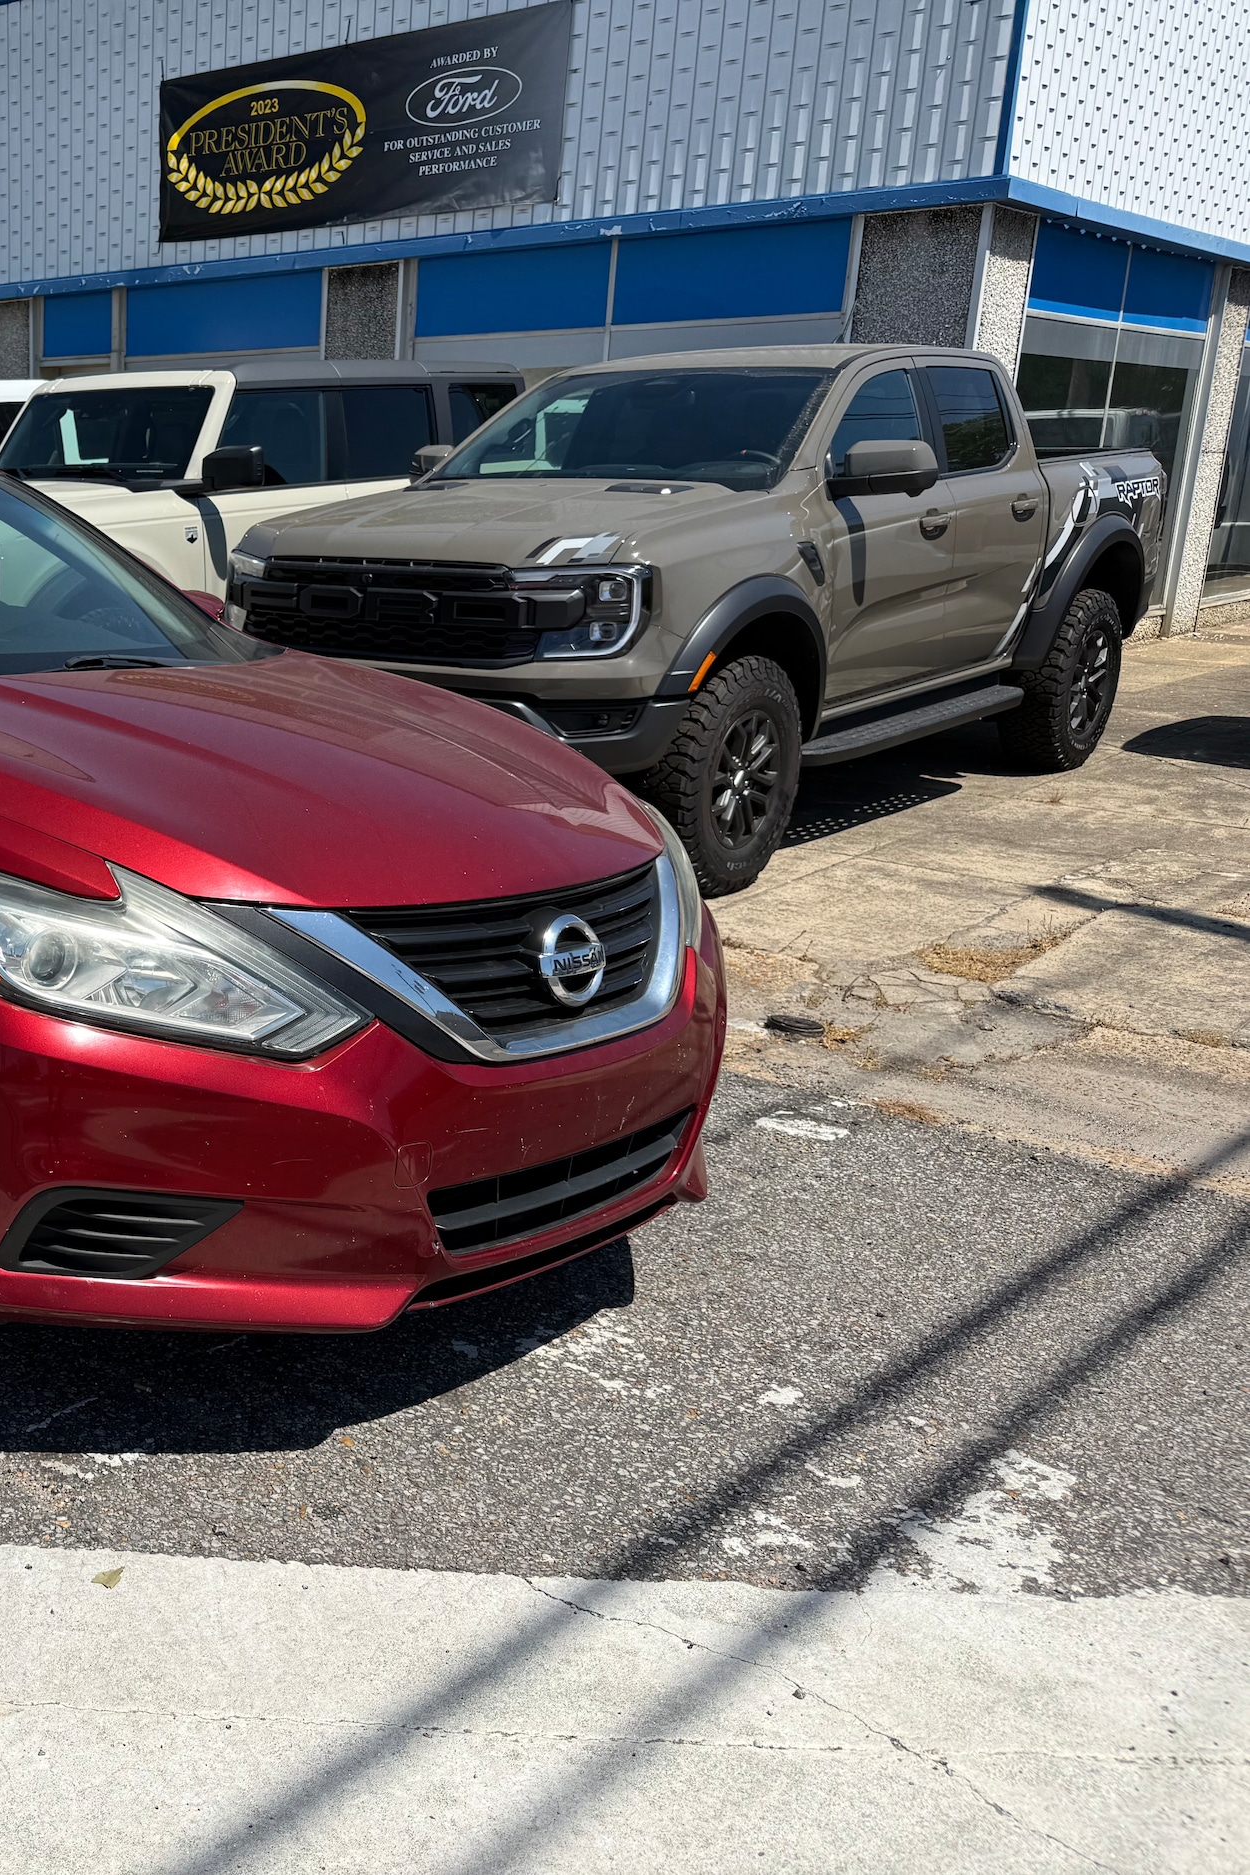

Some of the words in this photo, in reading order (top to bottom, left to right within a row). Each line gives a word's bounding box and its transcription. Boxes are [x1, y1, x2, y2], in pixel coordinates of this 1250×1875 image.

[430, 50, 481, 69] AWARDED
[483, 46, 499, 60] BY
[250, 98, 279, 116] 2023
[426, 75, 499, 118] Ford
[188, 107, 348, 157] PRESIDENT'S
[384, 139, 405, 152] FOR
[406, 128, 479, 149] OUTSTANDING
[481, 119, 541, 137] CUSTOMER
[219, 141, 307, 177] AWARD
[409, 147, 452, 164] SERVICE
[454, 144, 477, 157] AND
[478, 139, 511, 153] SALES
[418, 156, 498, 177] PERFORMANCE
[1115, 476, 1161, 508] RAPTOR
[244, 580, 530, 629] FORD
[552, 949, 605, 972] NISSAN
